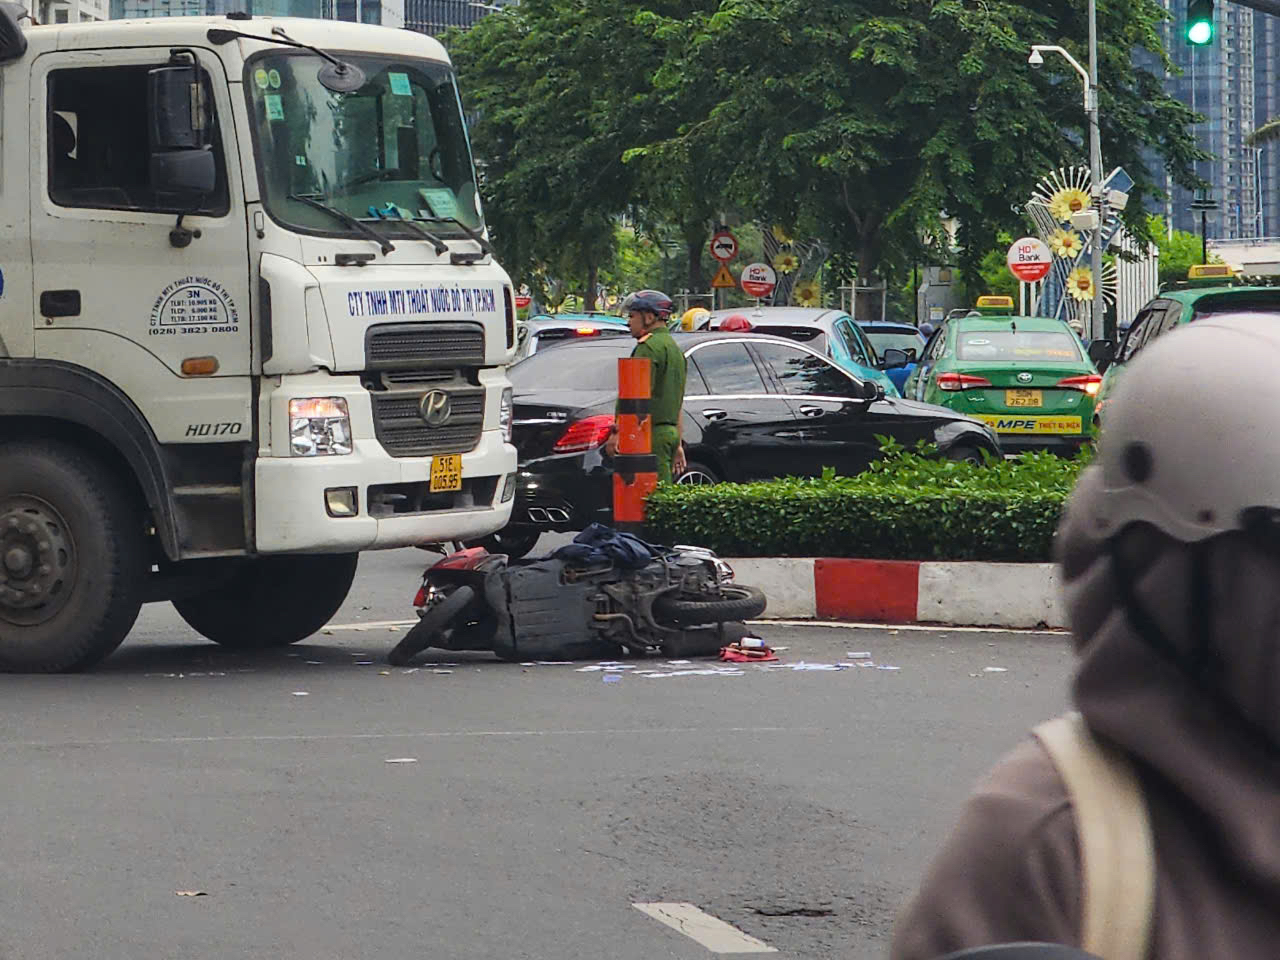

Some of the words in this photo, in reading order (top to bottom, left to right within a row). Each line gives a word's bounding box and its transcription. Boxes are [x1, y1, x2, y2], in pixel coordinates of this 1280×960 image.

[348, 291, 364, 316] CTY
[366, 291, 388, 315] TNHH
[389, 289, 405, 314] MTV
[407, 284, 429, 313] THOÁT
[997, 420, 1037, 428] MPE
